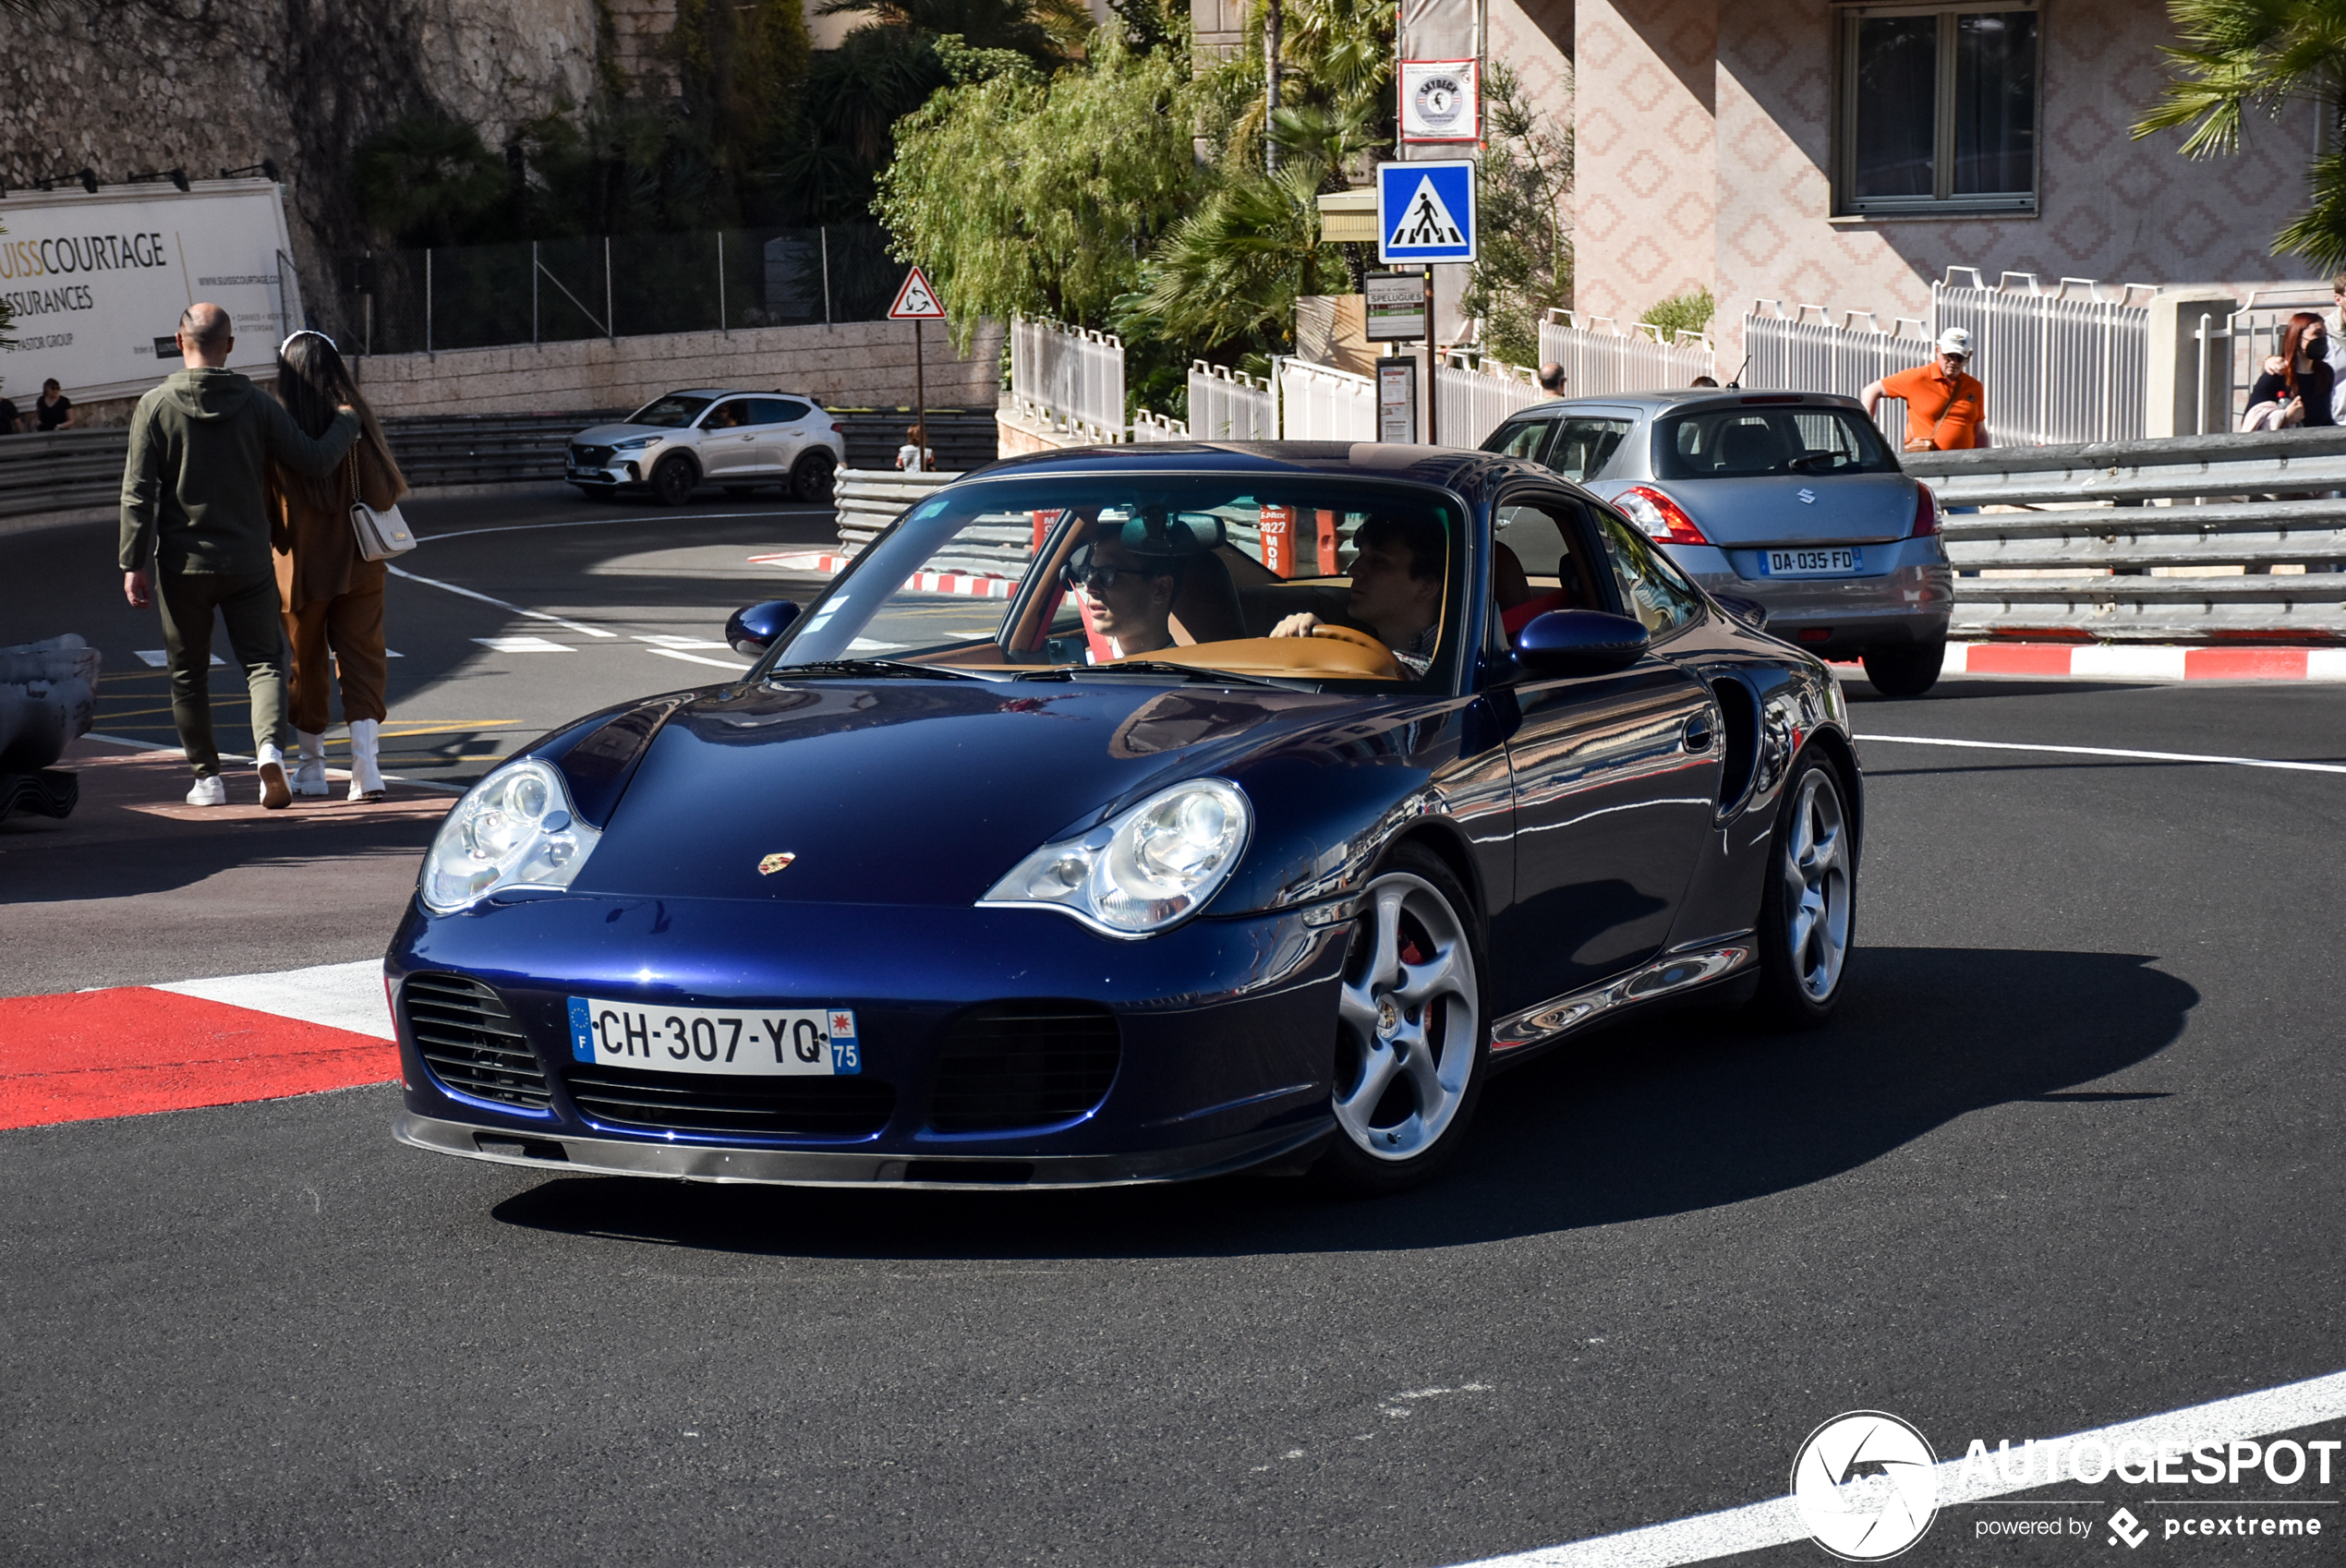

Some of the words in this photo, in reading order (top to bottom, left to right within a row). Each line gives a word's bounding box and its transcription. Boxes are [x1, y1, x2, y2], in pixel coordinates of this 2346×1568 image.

[1420, 79, 1458, 95] SKYDECK
[198, 275, 280, 285] WWW.SUISSCOURTAGE.CO
[1371, 293, 1422, 303] SPELUGUES
[46, 332, 73, 347] GROUP
[1260, 521, 1287, 533] 2022
[578, 1035, 586, 1048] F
[599, 1009, 820, 1064] CH-307-YQ
[833, 1044, 857, 1067] 75
